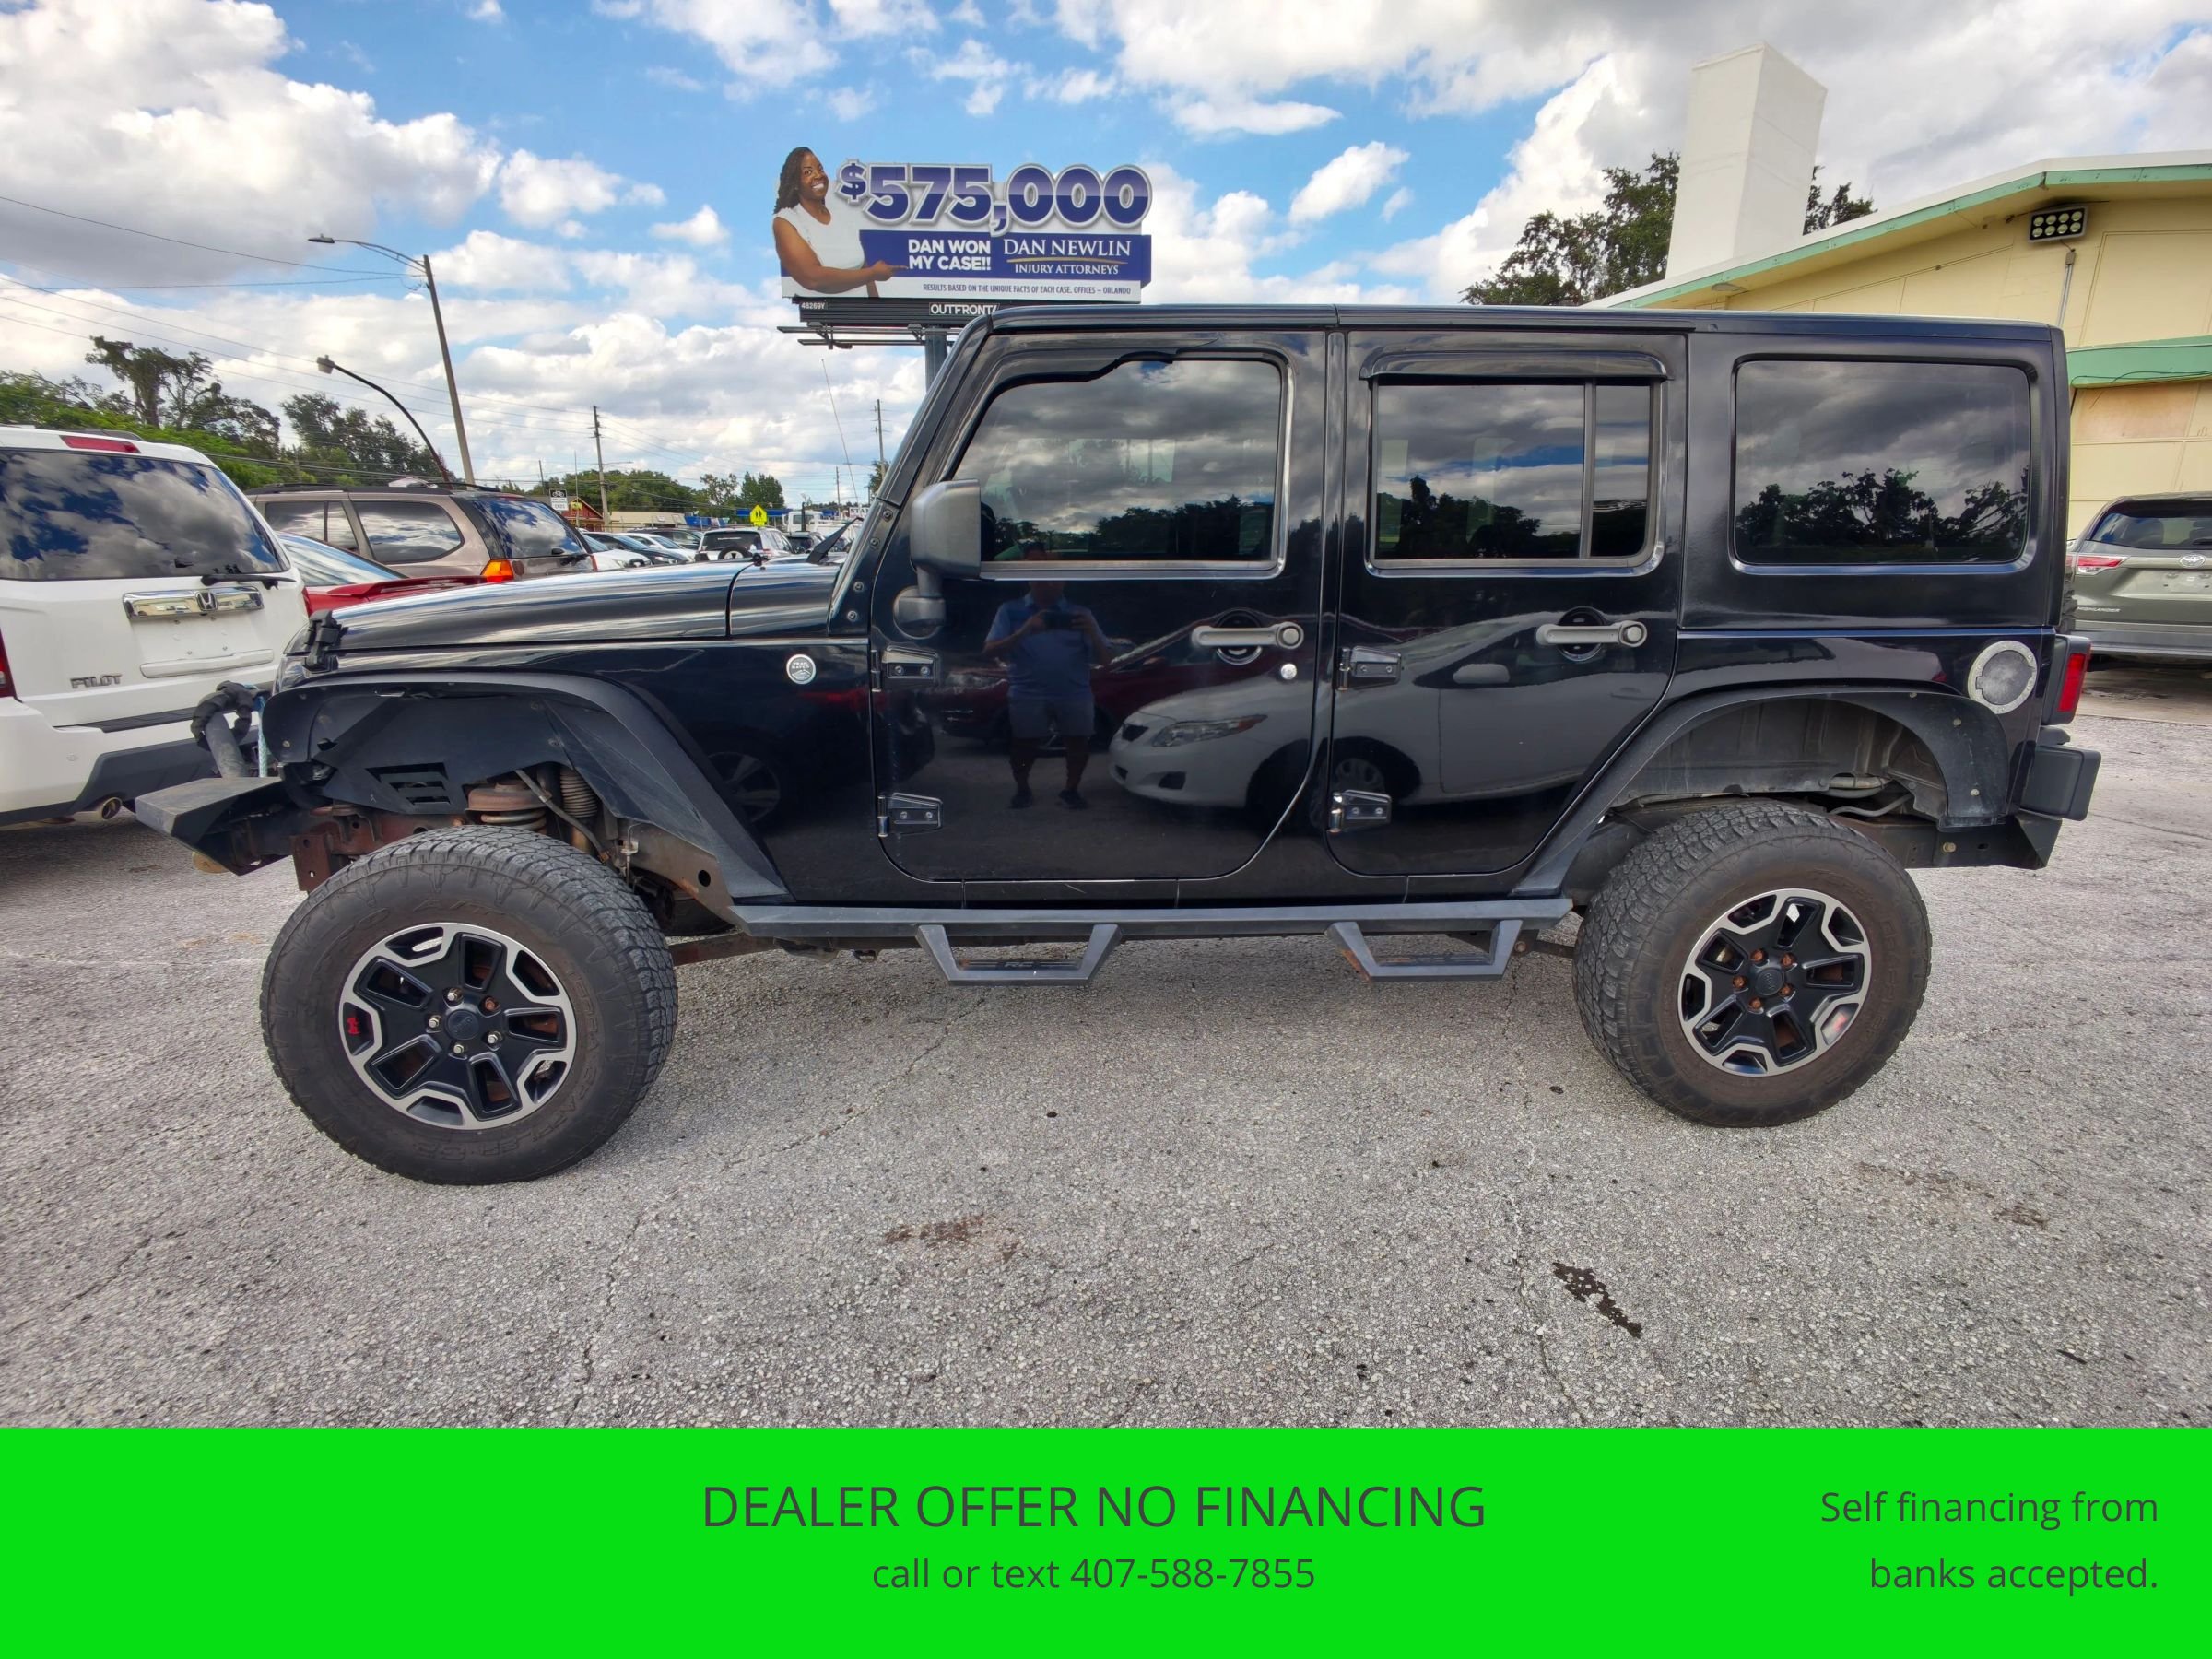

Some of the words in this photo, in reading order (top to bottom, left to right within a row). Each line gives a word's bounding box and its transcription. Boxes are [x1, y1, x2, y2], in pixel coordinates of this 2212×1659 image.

[838, 160, 1151, 233] $575,000
[908, 239, 945, 253] DAN
[947, 240, 991, 254] WON
[1004, 239, 1046, 255] DAN
[1051, 240, 1132, 256] NEWLIN
[909, 255, 934, 270] MY
[937, 256, 991, 271] CASE!!
[1015, 264, 1053, 274] INJURY
[1055, 265, 1119, 275] ATTORNEYS
[947, 284, 967, 292] BASED
[990, 285, 1012, 293] UNIQUE
[1040, 286, 1055, 294] EACH
[1102, 287, 1131, 295] ORLANDO
[70, 674, 123, 689] PILOT
